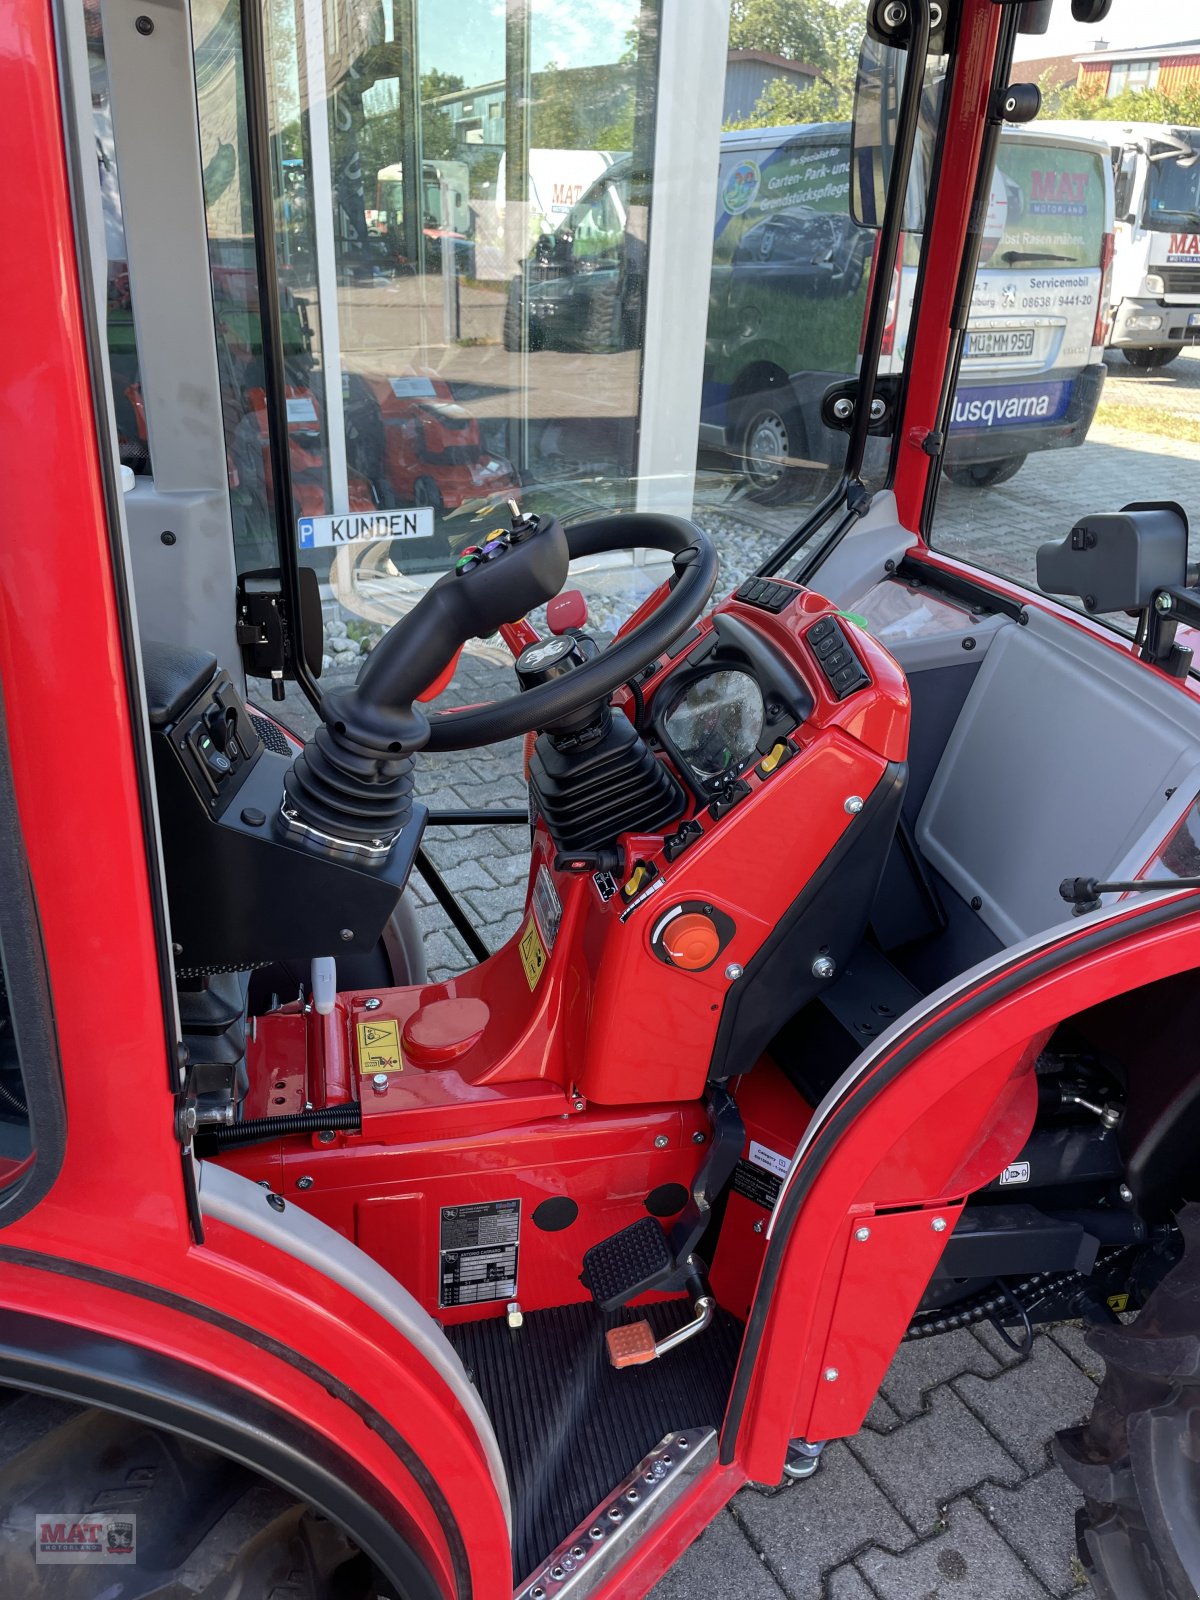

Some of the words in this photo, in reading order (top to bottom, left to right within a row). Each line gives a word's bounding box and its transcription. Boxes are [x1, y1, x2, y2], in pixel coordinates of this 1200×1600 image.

[768, 174, 803, 190] Garten-
[804, 164, 830, 181] Park-
[1031, 170, 1089, 202] MAT
[552, 183, 582, 205] MAT
[760, 182, 849, 211] Grundstückspflege
[1034, 203, 1083, 214] MOTORLAND
[1022, 232, 1053, 245] Rasen
[1168, 232, 1200, 255] MA
[983, 282, 988, 291] 7
[1030, 276, 1089, 289] Servicemobil
[1022, 296, 1051, 308] 08638
[1057, 295, 1092, 306] 9441-20
[970, 335, 987, 352] MÜ
[993, 335, 1009, 350] MM
[1011, 333, 1032, 350] 950
[301, 525, 313, 543] P
[331, 513, 417, 542] KUNDEN
